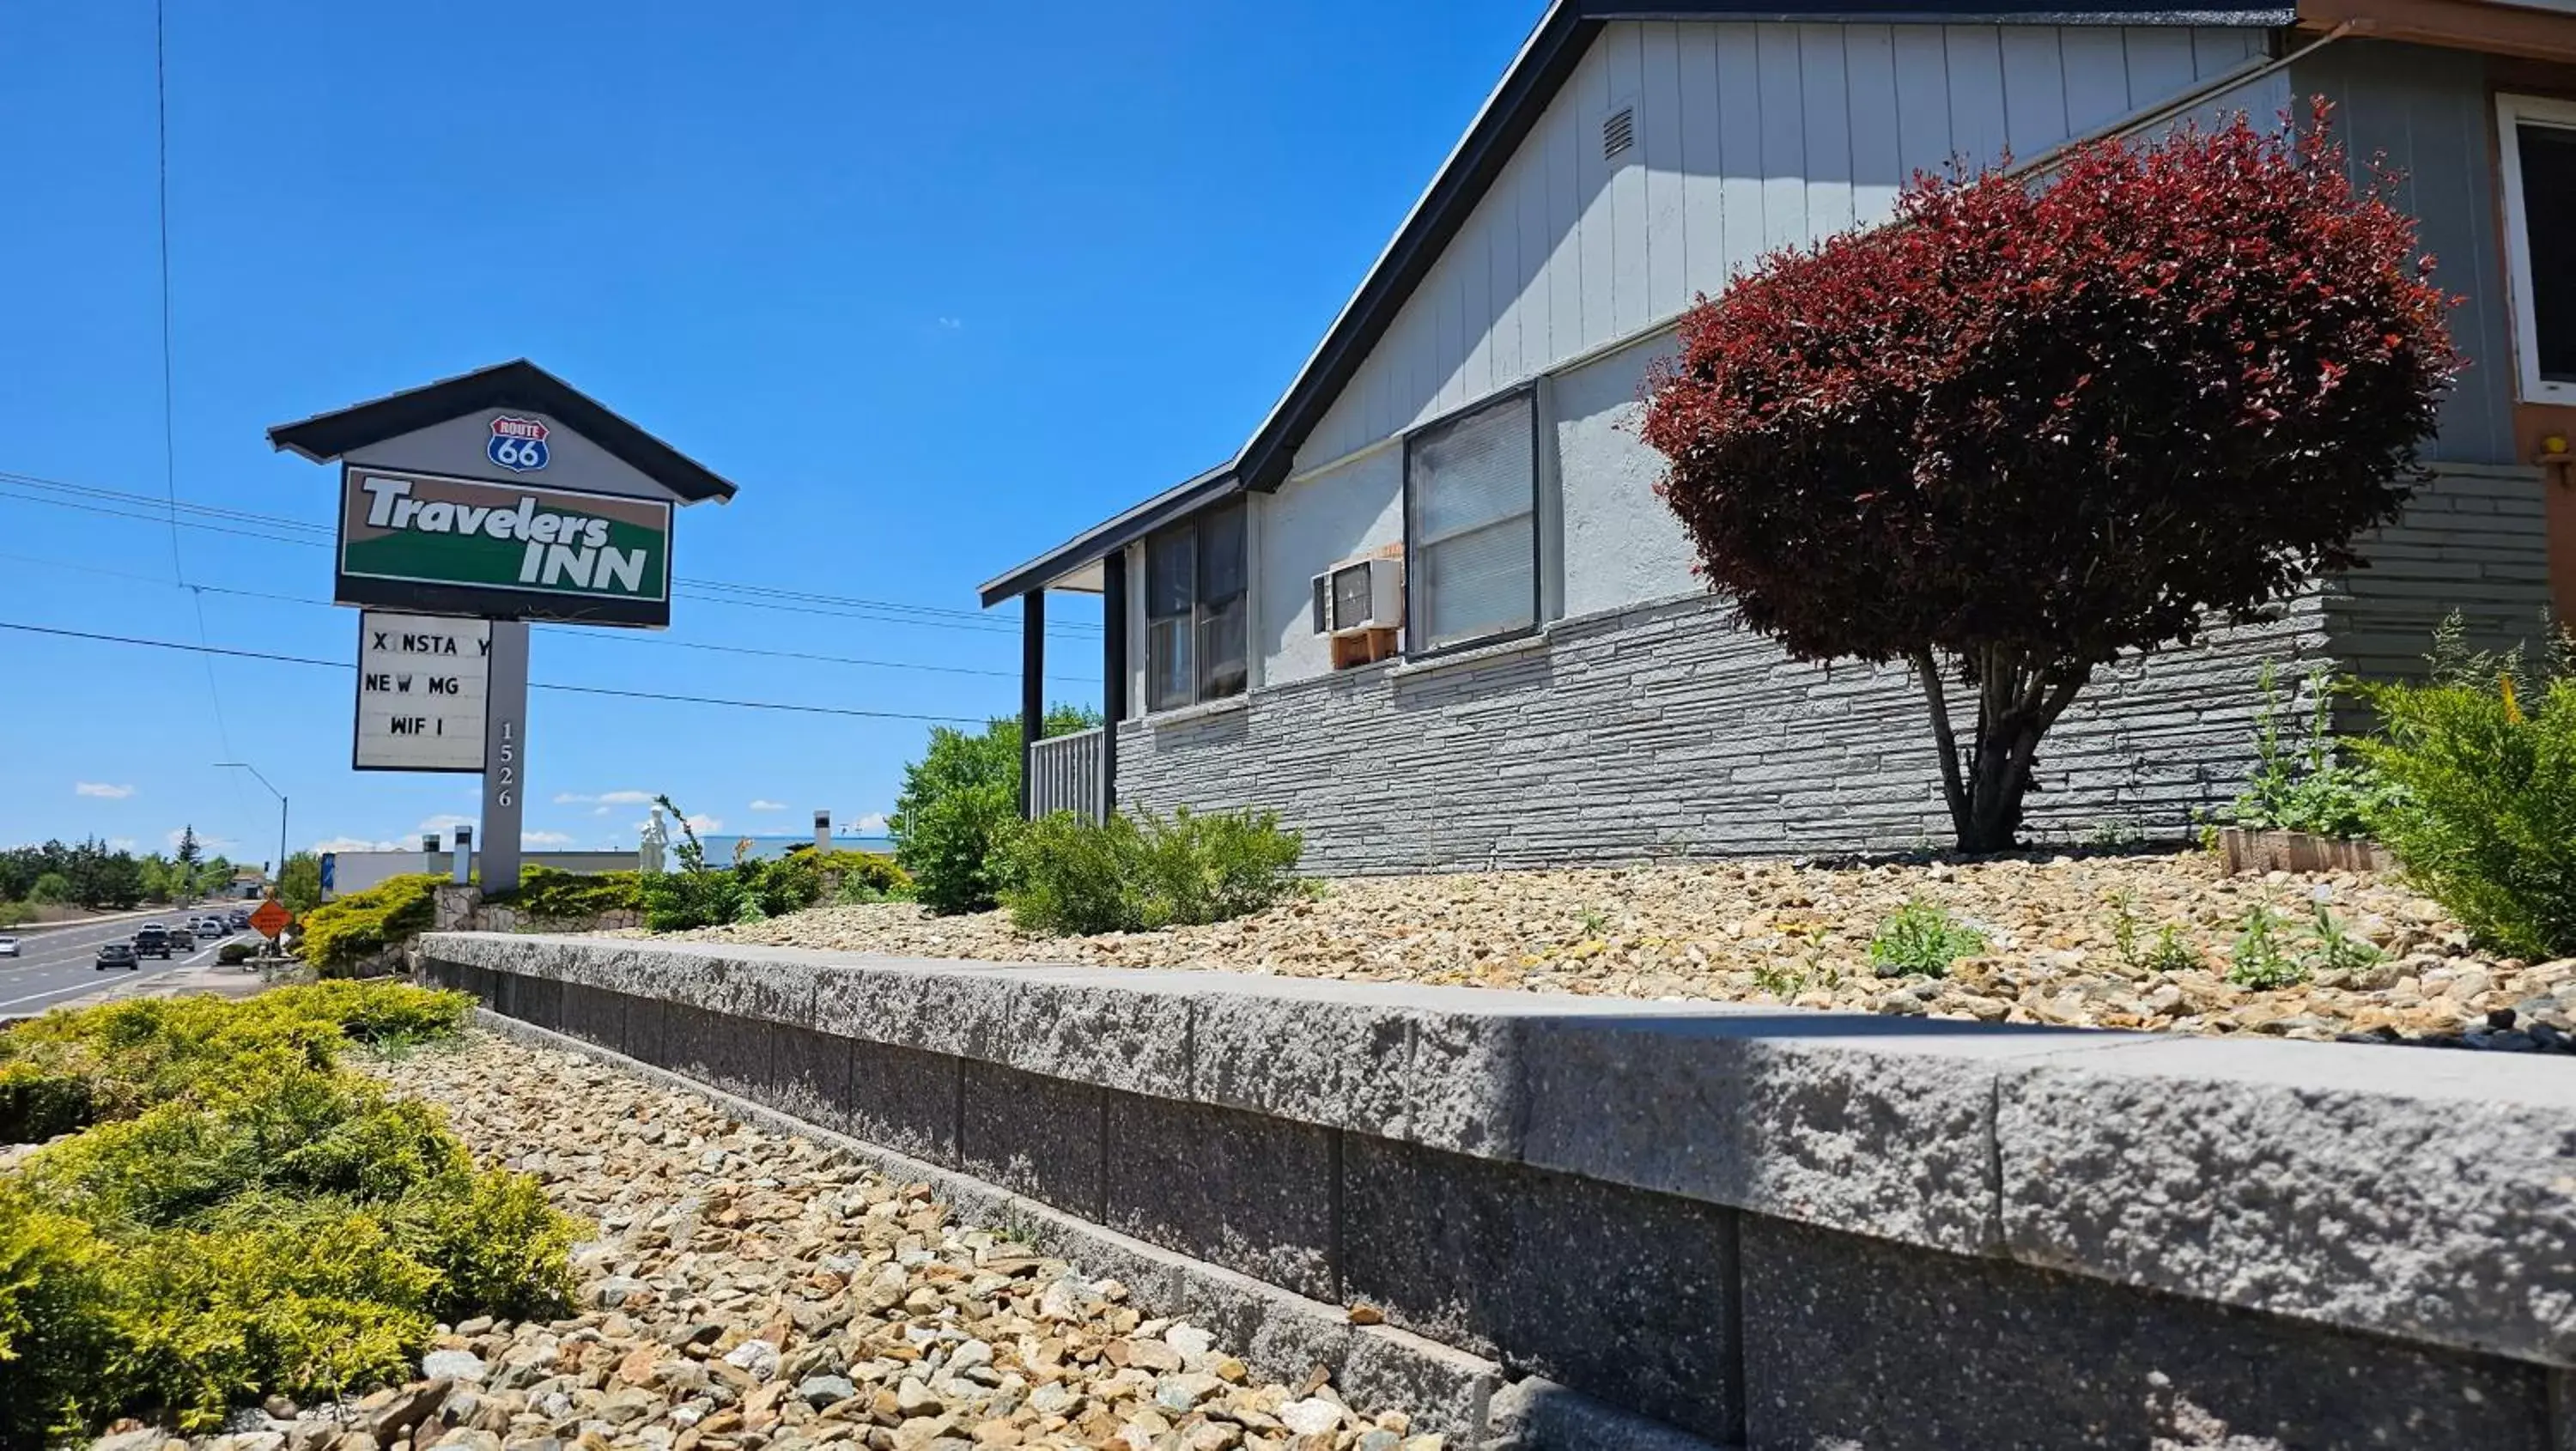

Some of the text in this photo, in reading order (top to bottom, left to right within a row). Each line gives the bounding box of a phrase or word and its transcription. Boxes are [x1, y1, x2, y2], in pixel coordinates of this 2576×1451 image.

[501, 422, 539, 436] ROUTE
[498, 439, 538, 466] 66
[363, 477, 611, 548] Travelers
[519, 540, 647, 592] INN
[365, 673, 459, 695] NEW MG
[499, 722, 513, 806] 1526
